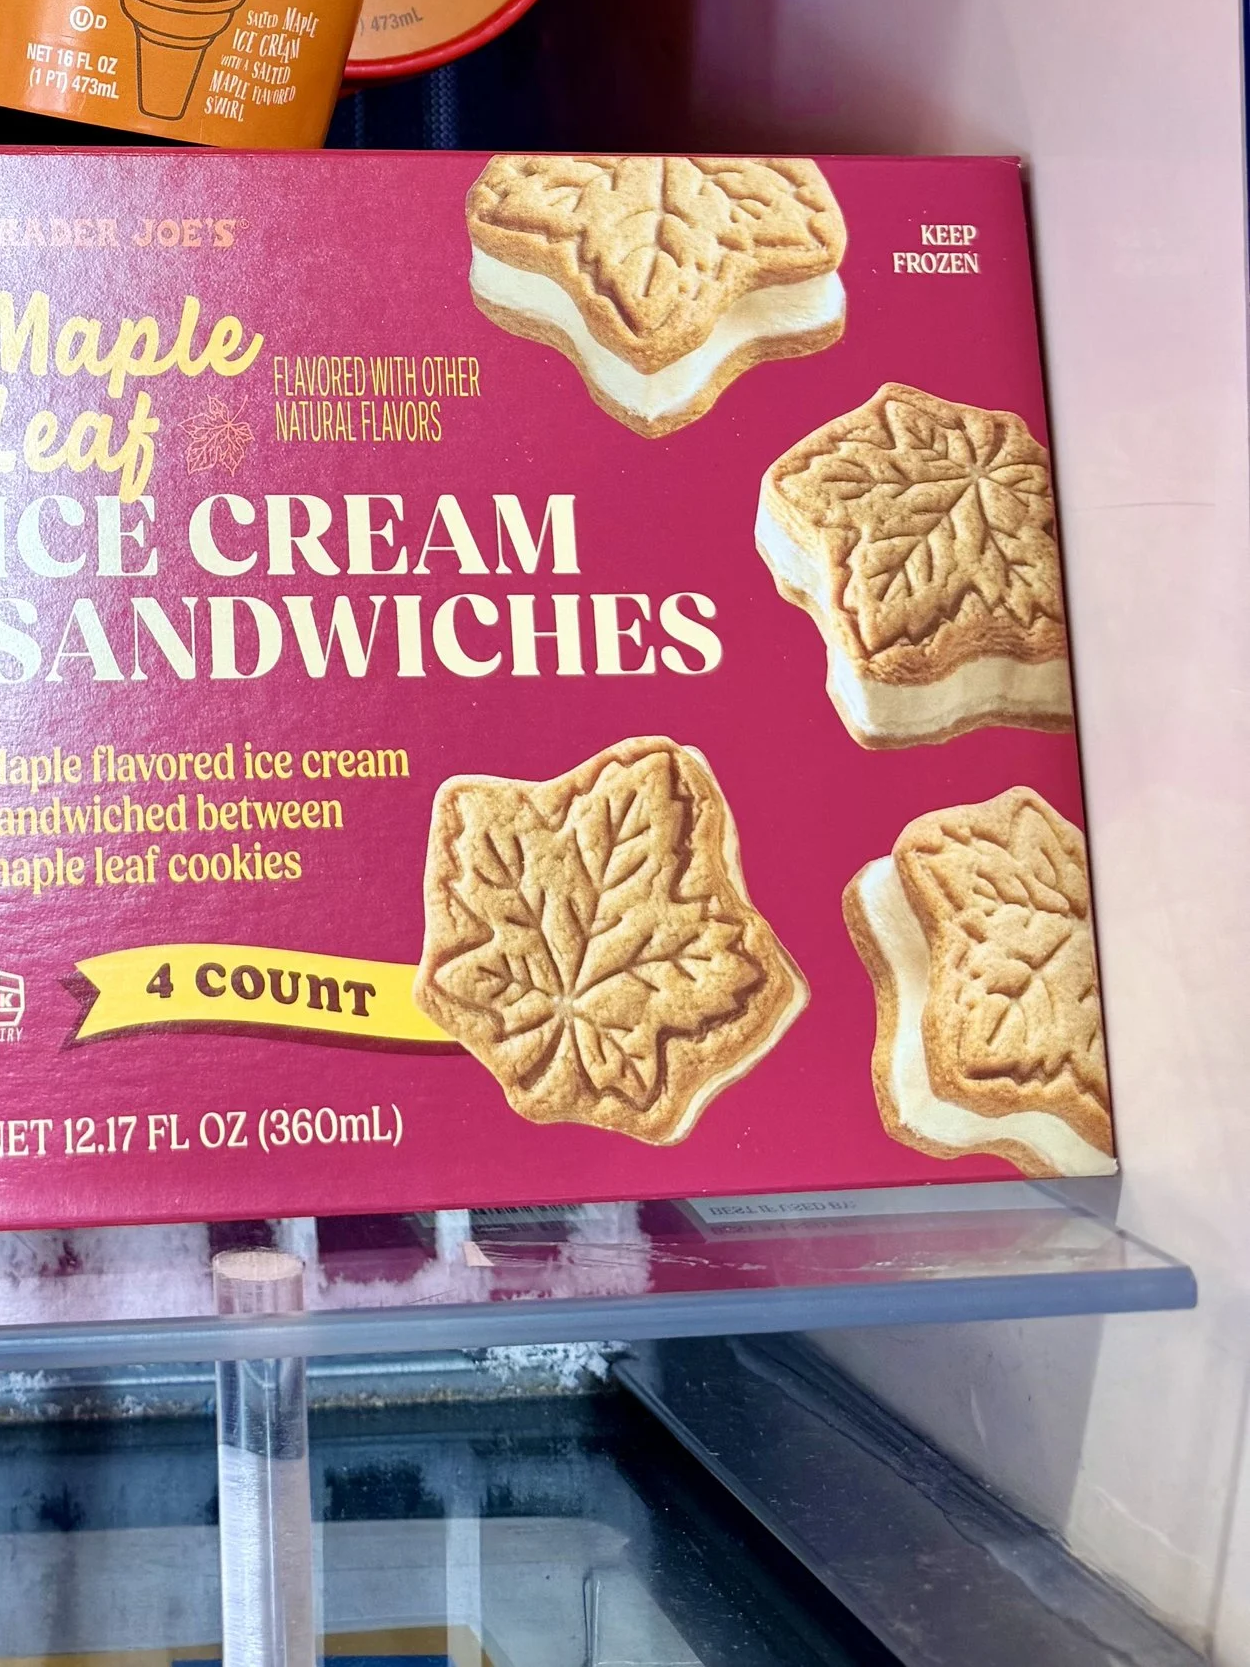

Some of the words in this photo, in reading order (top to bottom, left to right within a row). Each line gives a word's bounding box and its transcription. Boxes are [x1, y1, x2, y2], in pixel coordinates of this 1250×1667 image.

[246, 9, 278, 28] SALTED
[26, 42, 52, 63] NET
[56, 48, 73, 68] 16
[77, 51, 92, 70] FL
[97, 54, 116, 73] OZ
[233, 29, 254, 53] ICE
[259, 34, 300, 63] CREAM
[29, 68, 41, 88] (1
[45, 69, 68, 92] PT)
[71, 74, 119, 99] 473mL
[252, 61, 290, 84] SALTED
[204, 96, 244, 121] SWIRL
[252, 85, 296, 105] FLAVORED
[920, 224, 977, 247] KEEP
[892, 252, 980, 274] FROZEN
[274, 356, 366, 397] FLAVORED
[371, 356, 417, 395] WITH
[421, 356, 481, 397] OTHER
[274, 402, 355, 442] NATURAL
[362, 400, 443, 442] FLAVORS
[188, 492, 581, 577] CREAM
[91, 744, 235, 781] flavored
[244, 743, 295, 780] ice
[300, 748, 409, 780] cream
[198, 794, 344, 830] between
[95, 844, 158, 883] leaf
[168, 844, 302, 882] cookies
[145, 963, 174, 999] 4
[63, 1116, 137, 1155] 12.17
[149, 1116, 188, 1152] FL
[198, 1111, 248, 1149] OZ
[258, 1104, 404, 1154] (360mL)
